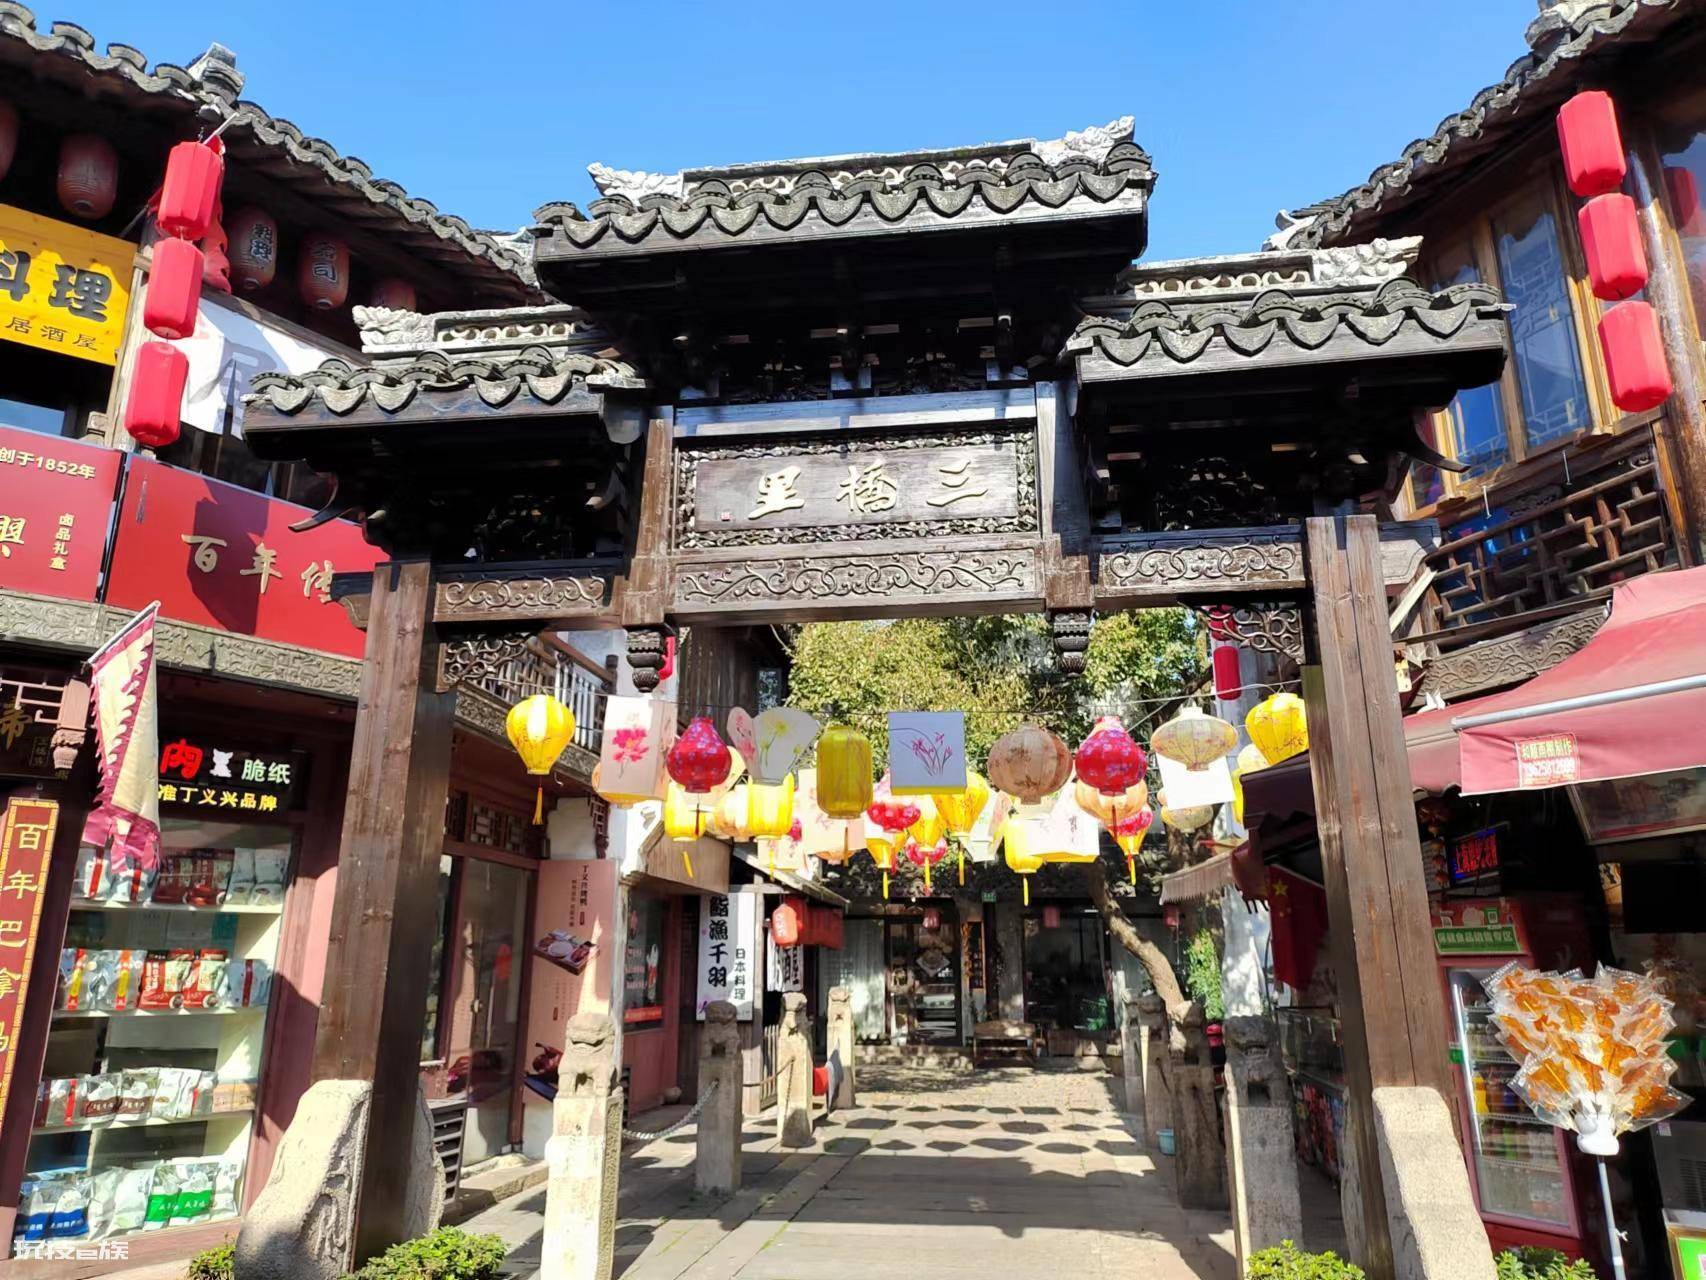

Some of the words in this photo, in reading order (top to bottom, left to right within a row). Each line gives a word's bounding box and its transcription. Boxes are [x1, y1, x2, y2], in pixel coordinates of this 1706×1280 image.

[6, 316, 98, 352] 居酒屋
[0, 446, 96, 480] 创于1852年
[49, 513, 75, 570] 卤品礼盒
[241, 759, 292, 785] 脆纸
[734, 948, 746, 1001] 日本料理
